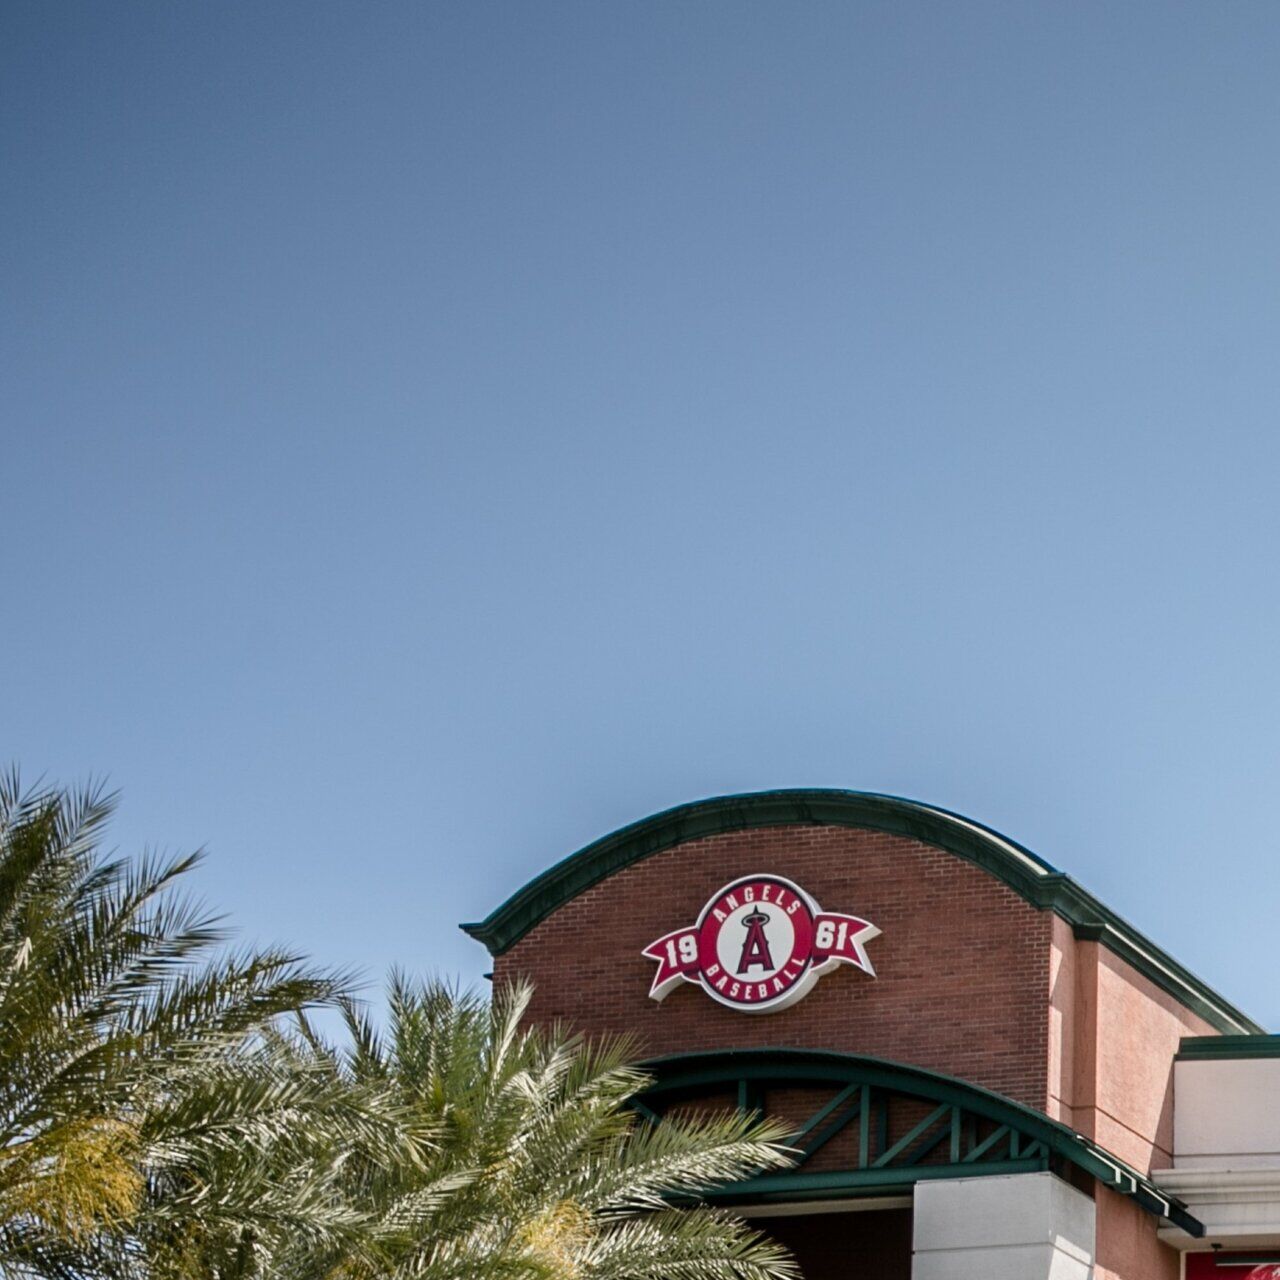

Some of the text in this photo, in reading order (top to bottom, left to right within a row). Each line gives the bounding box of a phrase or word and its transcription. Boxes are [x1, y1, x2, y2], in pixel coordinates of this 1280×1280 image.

[713, 885, 801, 923] ANGELS
[665, 935, 699, 969] 19
[815, 920, 848, 951] 61
[706, 959, 805, 1000] BASEBALL
